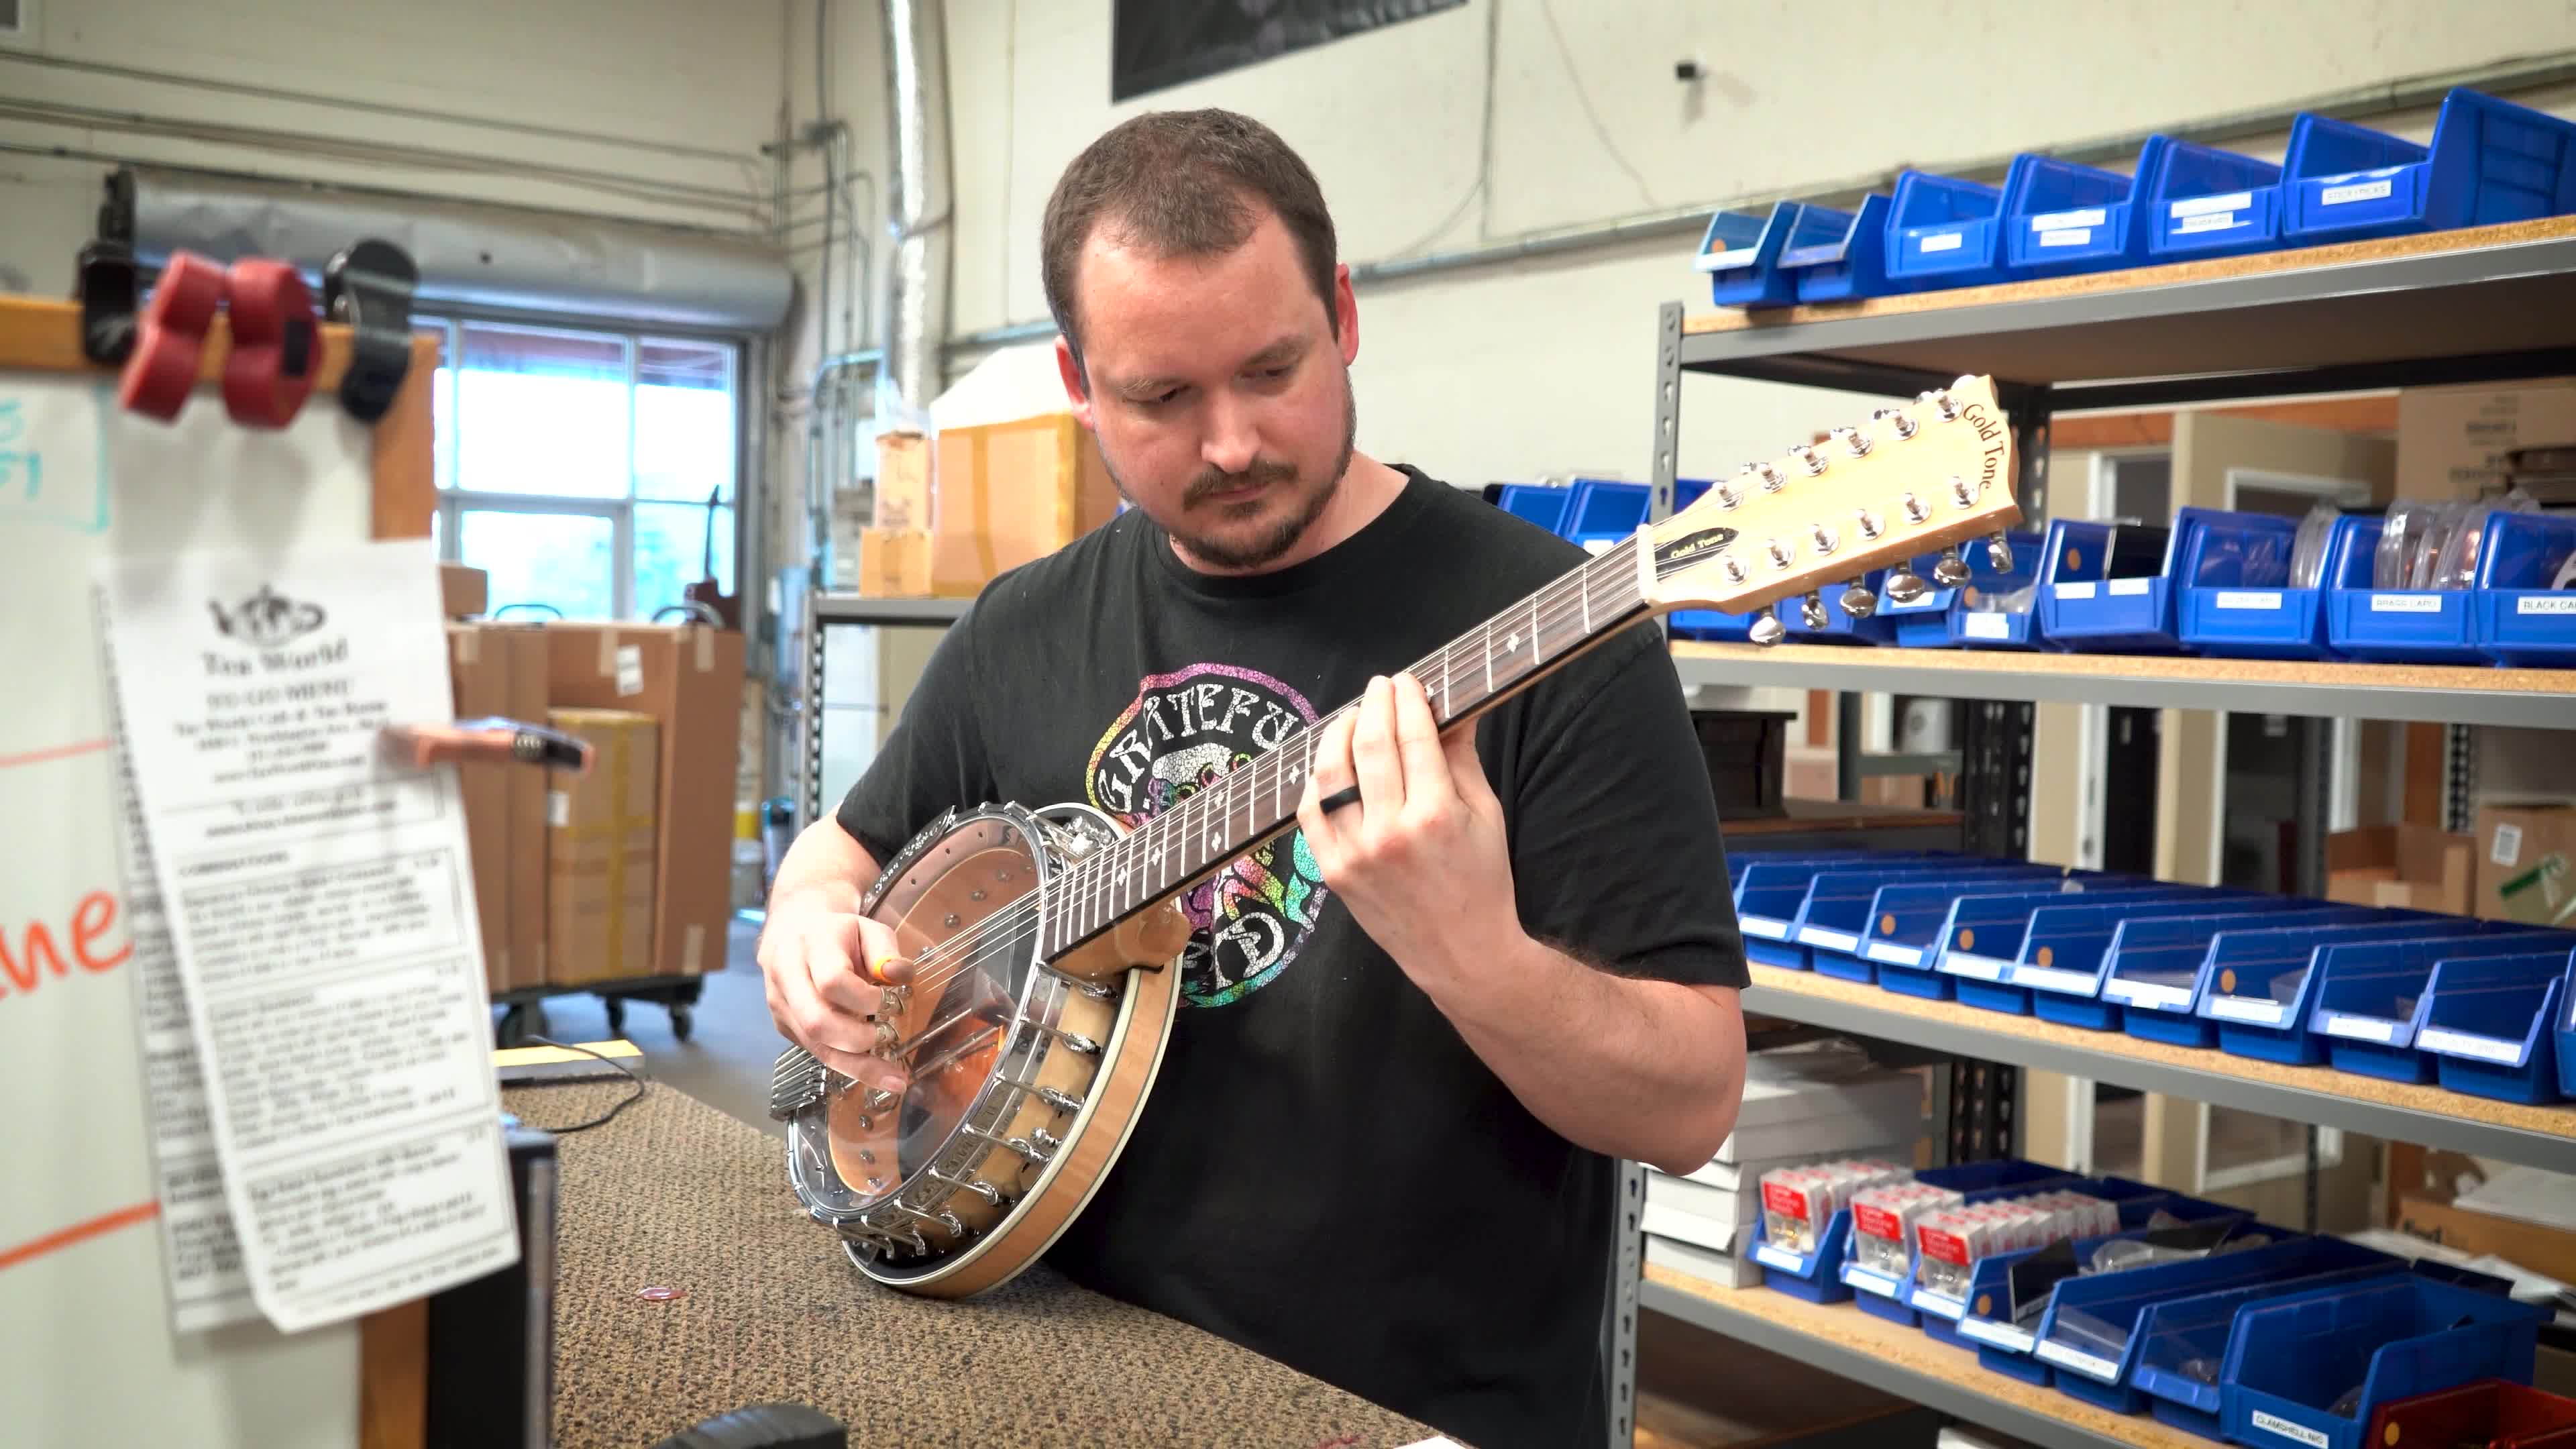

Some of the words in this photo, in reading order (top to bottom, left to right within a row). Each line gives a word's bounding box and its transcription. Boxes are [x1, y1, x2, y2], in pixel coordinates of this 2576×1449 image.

[1964, 404, 2002, 441] Gold
[1979, 440, 2005, 489] Tone
[1670, 543, 1697, 559] Gold
[1697, 533, 1724, 549] Tone
[2524, 600, 2555, 610] BLACK
[2559, 600, 2576, 610] CA
[1097, 683, 1300, 814] GRATEFU
